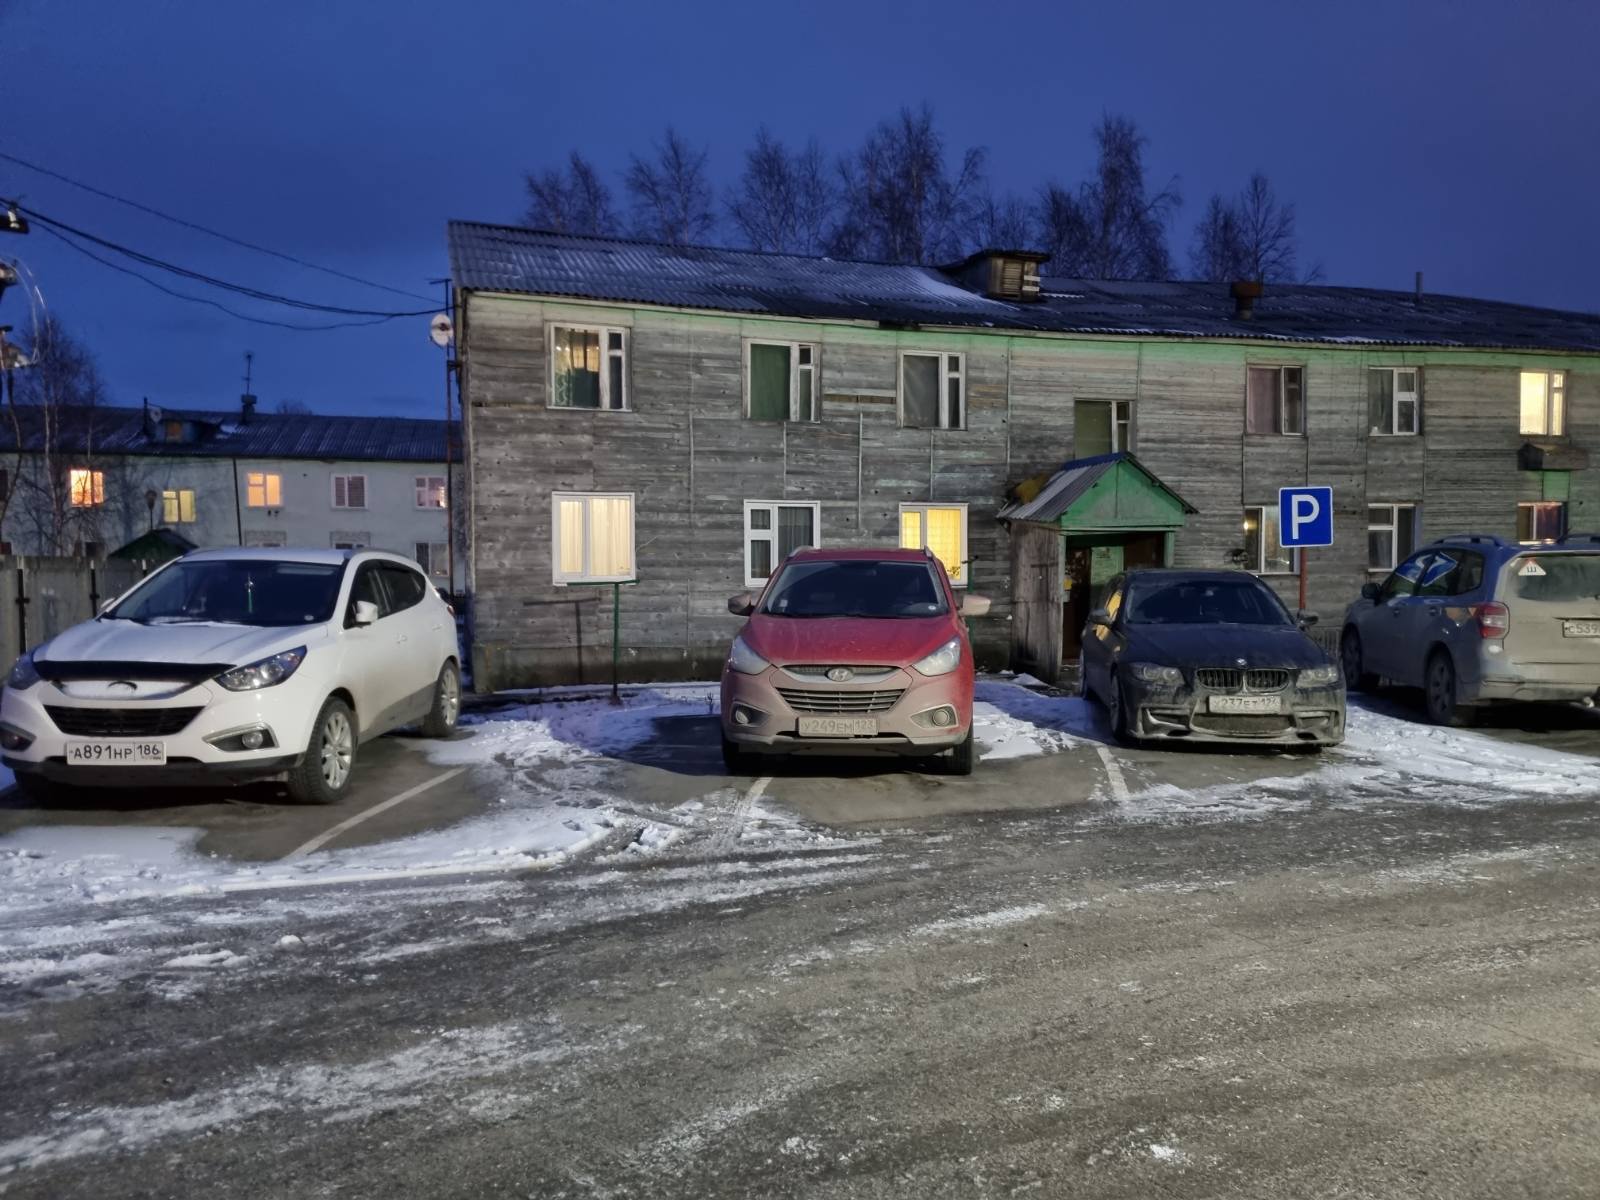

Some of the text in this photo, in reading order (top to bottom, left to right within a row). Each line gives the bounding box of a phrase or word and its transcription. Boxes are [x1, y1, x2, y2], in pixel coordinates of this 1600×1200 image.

[1291, 494, 1320, 540] P
[73, 744, 161, 760] А891НР 186
